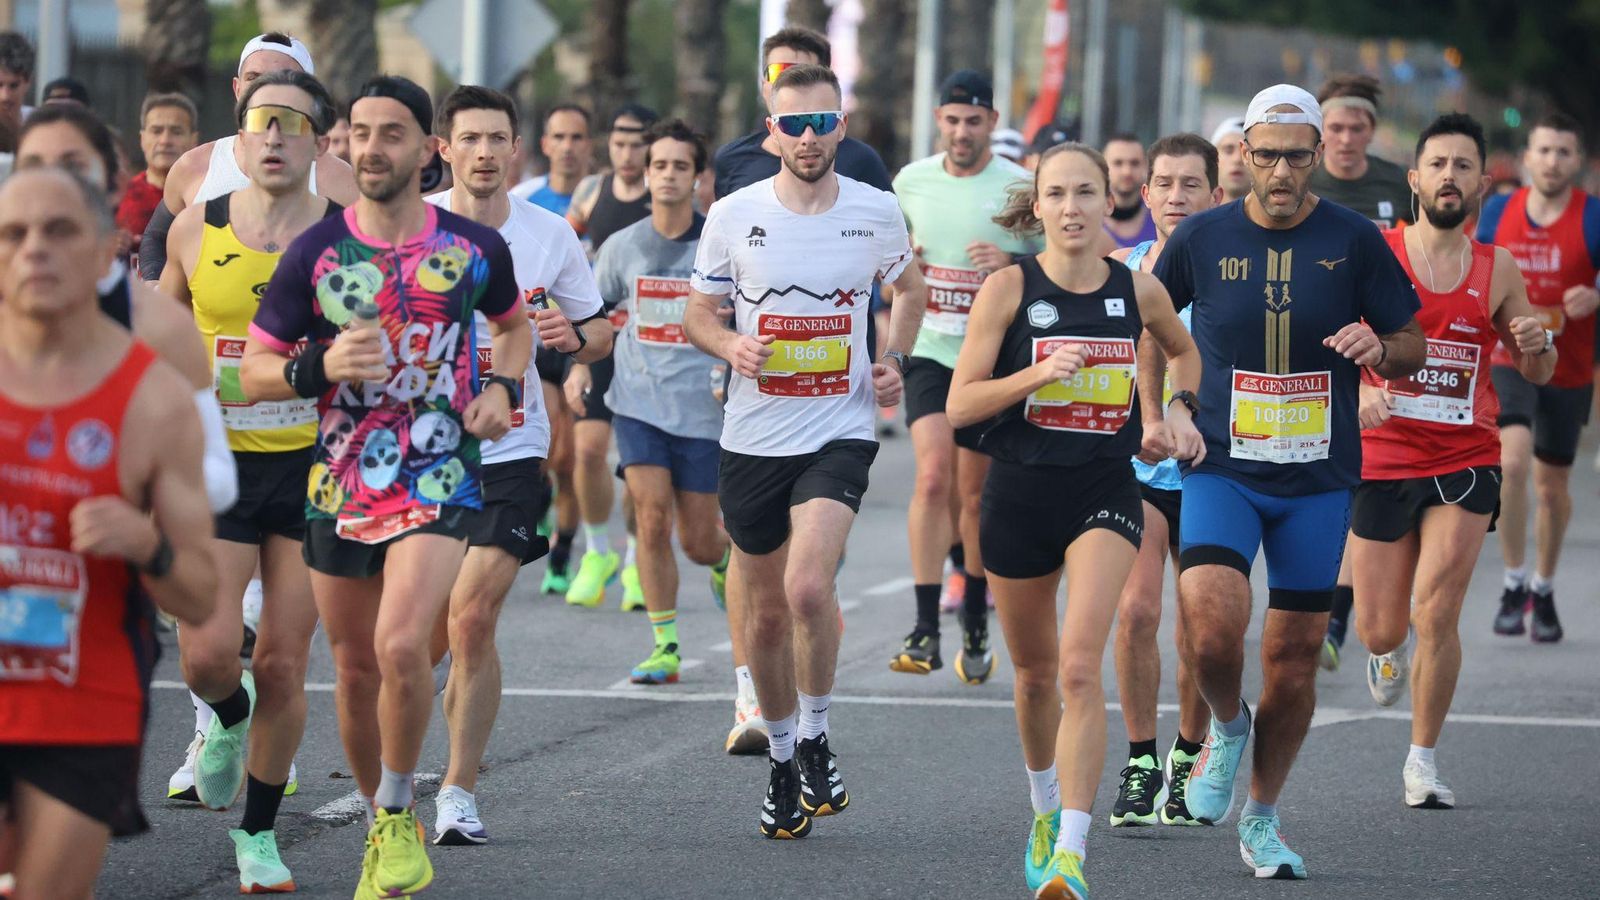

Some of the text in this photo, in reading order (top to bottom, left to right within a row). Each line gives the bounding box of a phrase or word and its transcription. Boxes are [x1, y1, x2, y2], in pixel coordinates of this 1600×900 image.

[841, 229, 875, 238] KIPRUN
[749, 239, 766, 247] FFL
[1218, 256, 1249, 280] 101
[931, 288, 972, 307] 13152
[784, 318, 846, 331] GENERALI
[784, 345, 828, 360] 1866
[1086, 342, 1130, 358] NERALI
[1409, 368, 1459, 387] 0346
[1260, 378, 1323, 393] GENERALI
[1254, 406, 1309, 423] 10820
